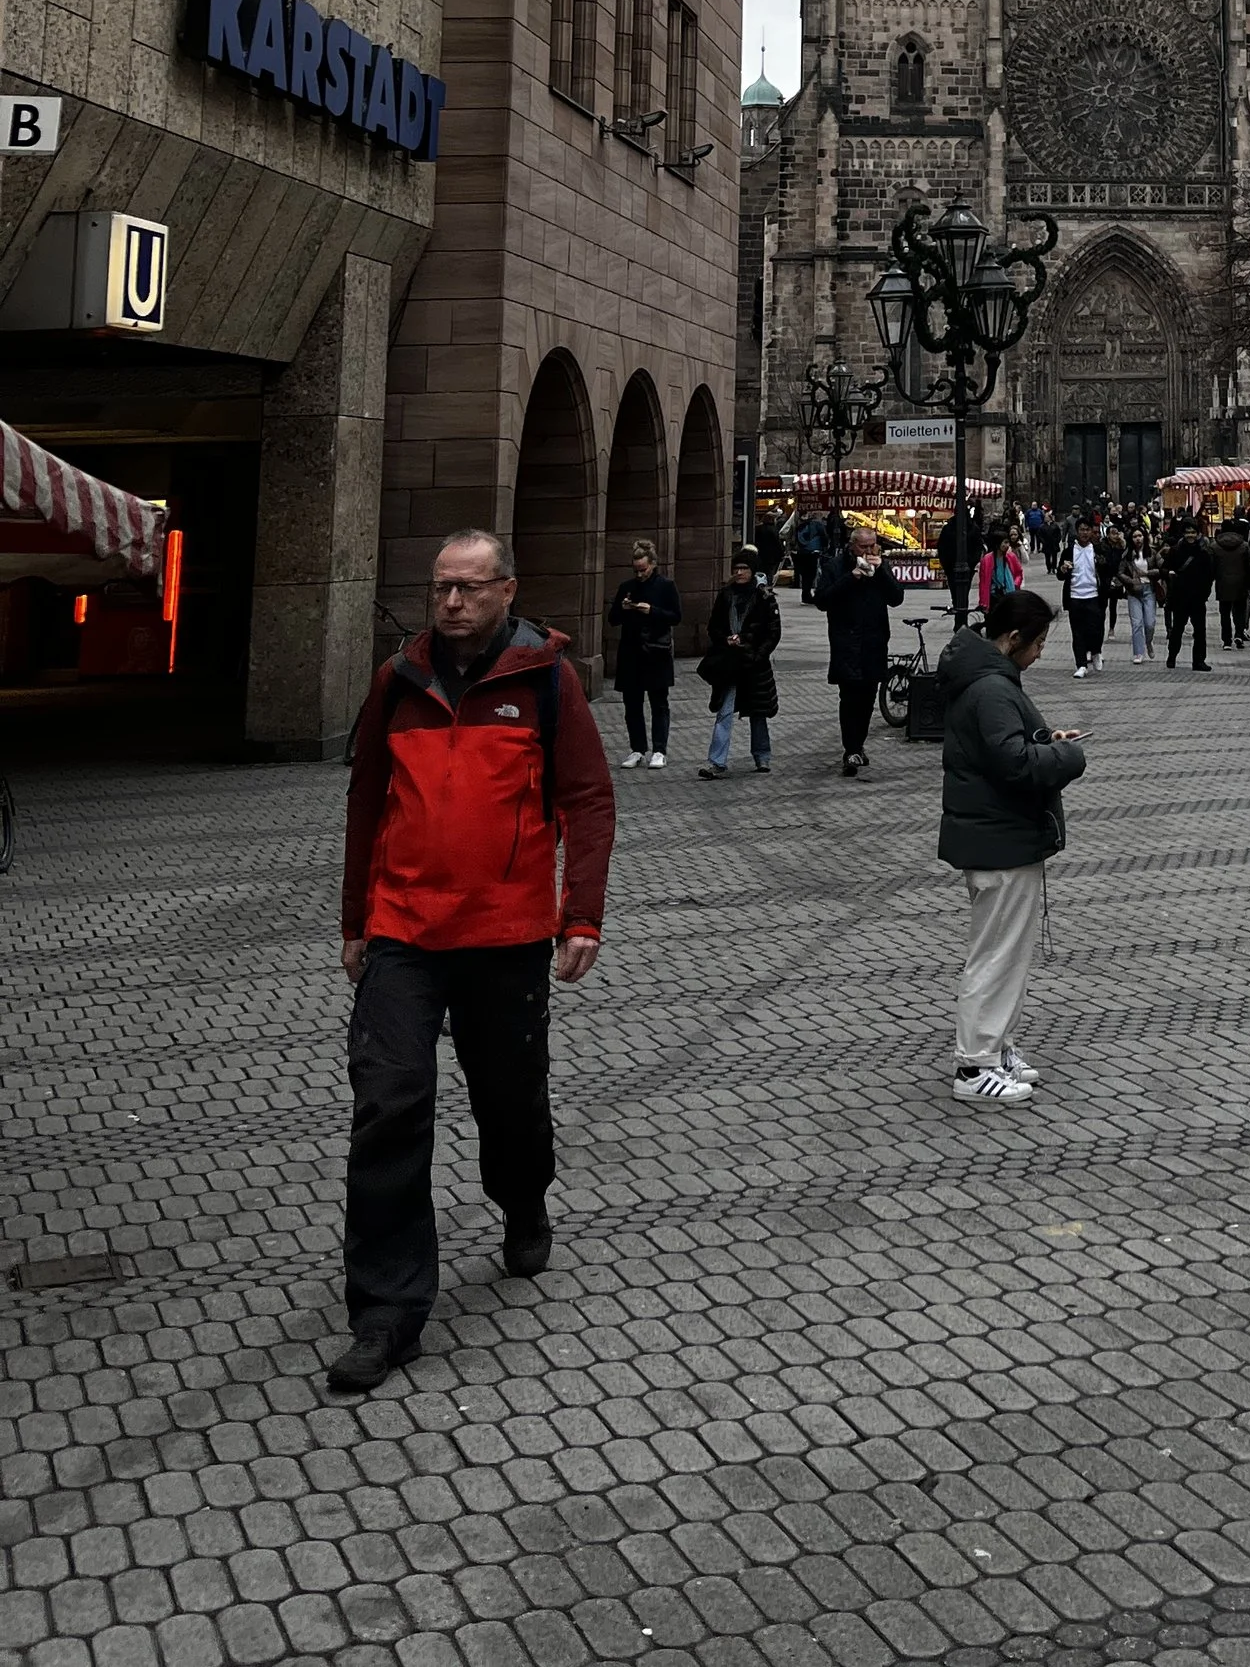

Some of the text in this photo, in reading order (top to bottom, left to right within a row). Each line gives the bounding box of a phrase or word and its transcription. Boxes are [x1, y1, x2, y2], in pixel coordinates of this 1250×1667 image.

[9, 103, 41, 146] B
[127, 231, 161, 317] U
[888, 426, 940, 437] Toiletten
[866, 495, 912, 507] TROCKEN
